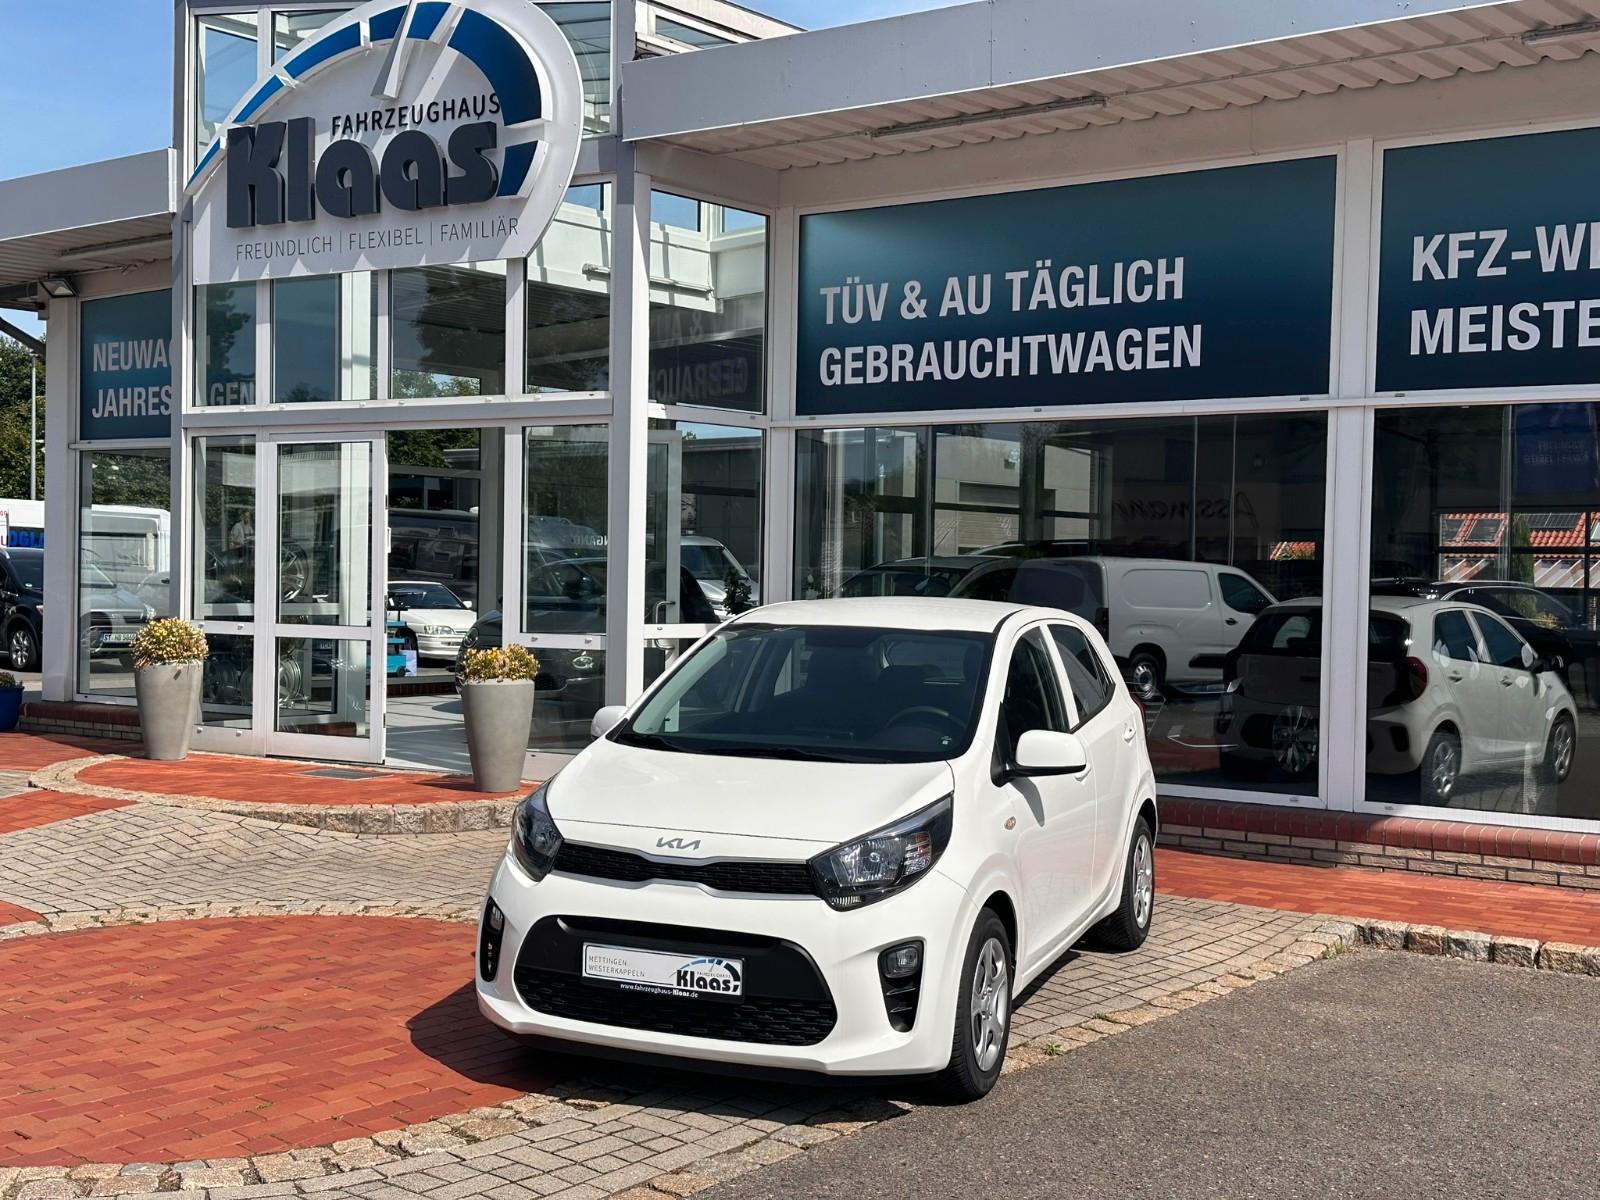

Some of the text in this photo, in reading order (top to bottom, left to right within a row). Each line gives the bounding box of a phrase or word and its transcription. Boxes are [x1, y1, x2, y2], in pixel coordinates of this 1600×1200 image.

[331, 92, 500, 137] FAHRZEUGHAUS
[226, 116, 498, 229] Klaas
[235, 217, 520, 262] FREUNDLICH FLEXIBEL FAMILIÄR
[819, 256, 1185, 325] TÜV & AU TÄGLICH
[1410, 299, 1600, 356] MEISTE
[819, 324, 1202, 387] GEBRAUCHTWAGEN
[656, 836, 701, 851] KIA
[676, 969, 731, 993] Klaas
